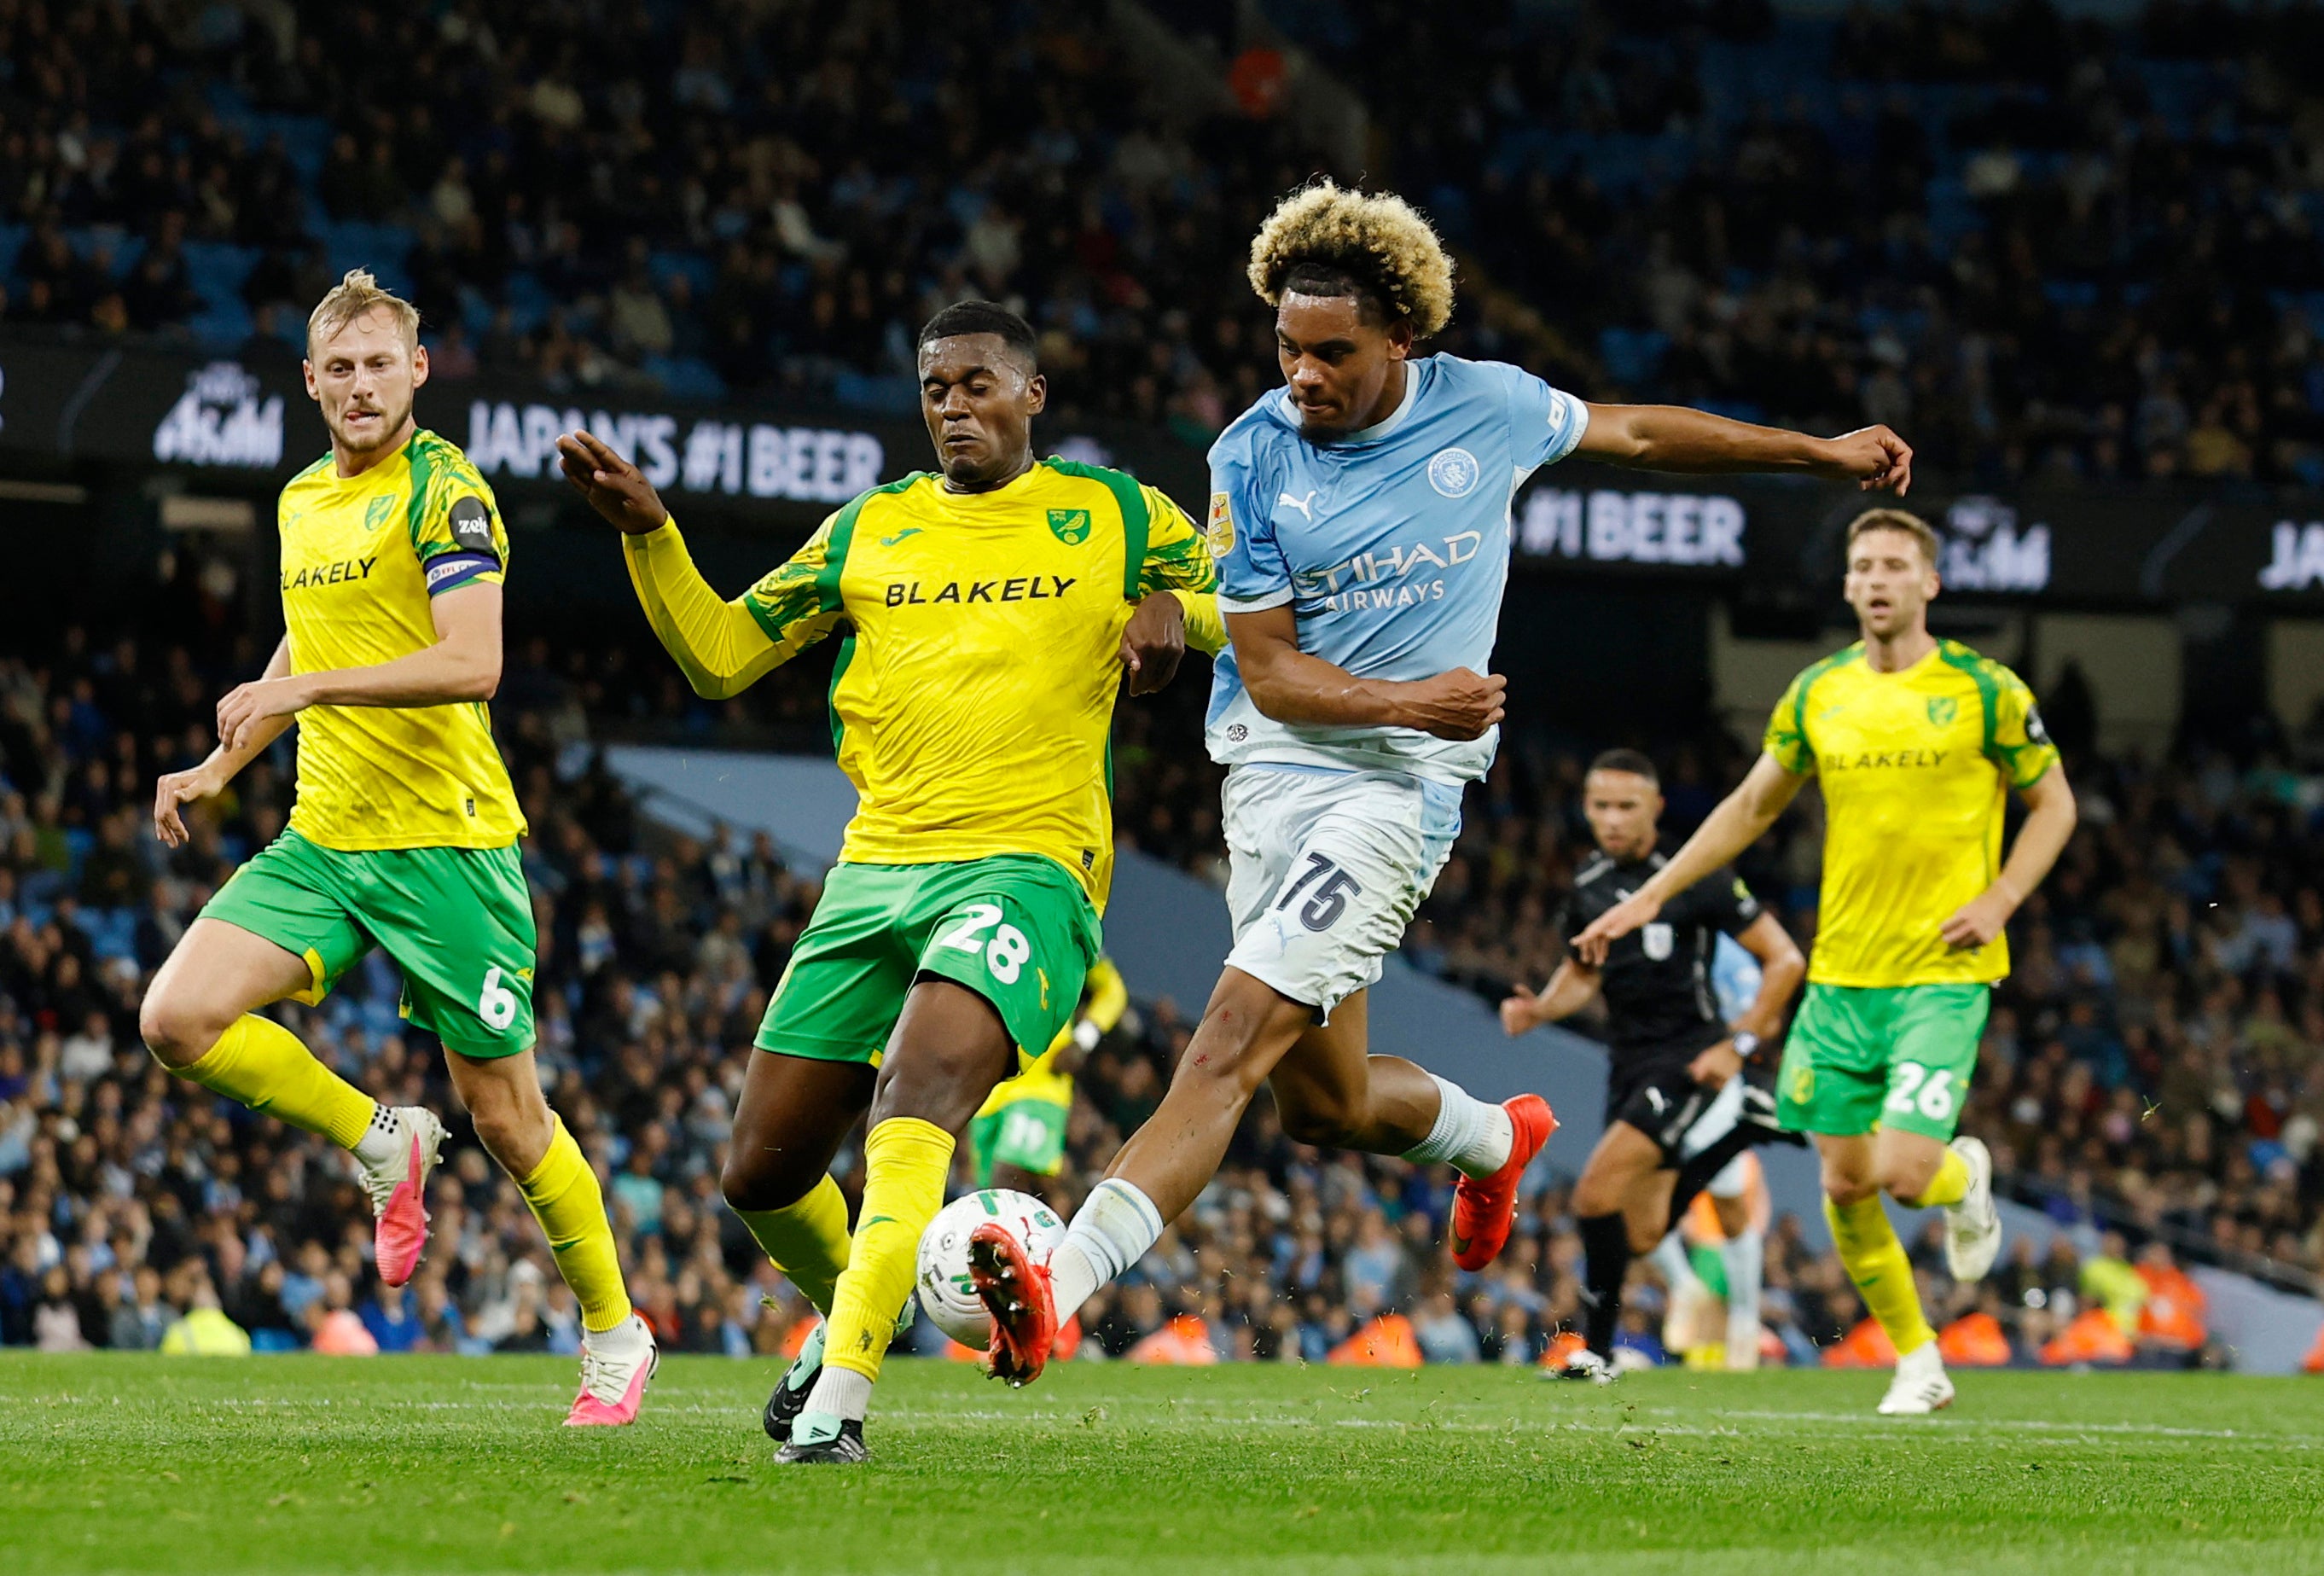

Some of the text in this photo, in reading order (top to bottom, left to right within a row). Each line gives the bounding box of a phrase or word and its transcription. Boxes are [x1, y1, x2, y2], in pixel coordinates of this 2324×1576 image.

[683, 422, 744, 495] #1
[748, 424, 885, 502] BEER
[1587, 489, 1746, 567] BEER
[280, 556, 377, 590] LAKELY
[886, 575, 1076, 608] BLAKELY
[1292, 530, 1482, 597] ETIHAD
[1325, 579, 1445, 613] AIRWAYS
[1825, 749, 1949, 771] BLAKELY
[1276, 852, 1363, 933] 75
[938, 903, 1031, 986] 28
[479, 966, 516, 1031] 6
[1884, 1061, 1952, 1121] 26
